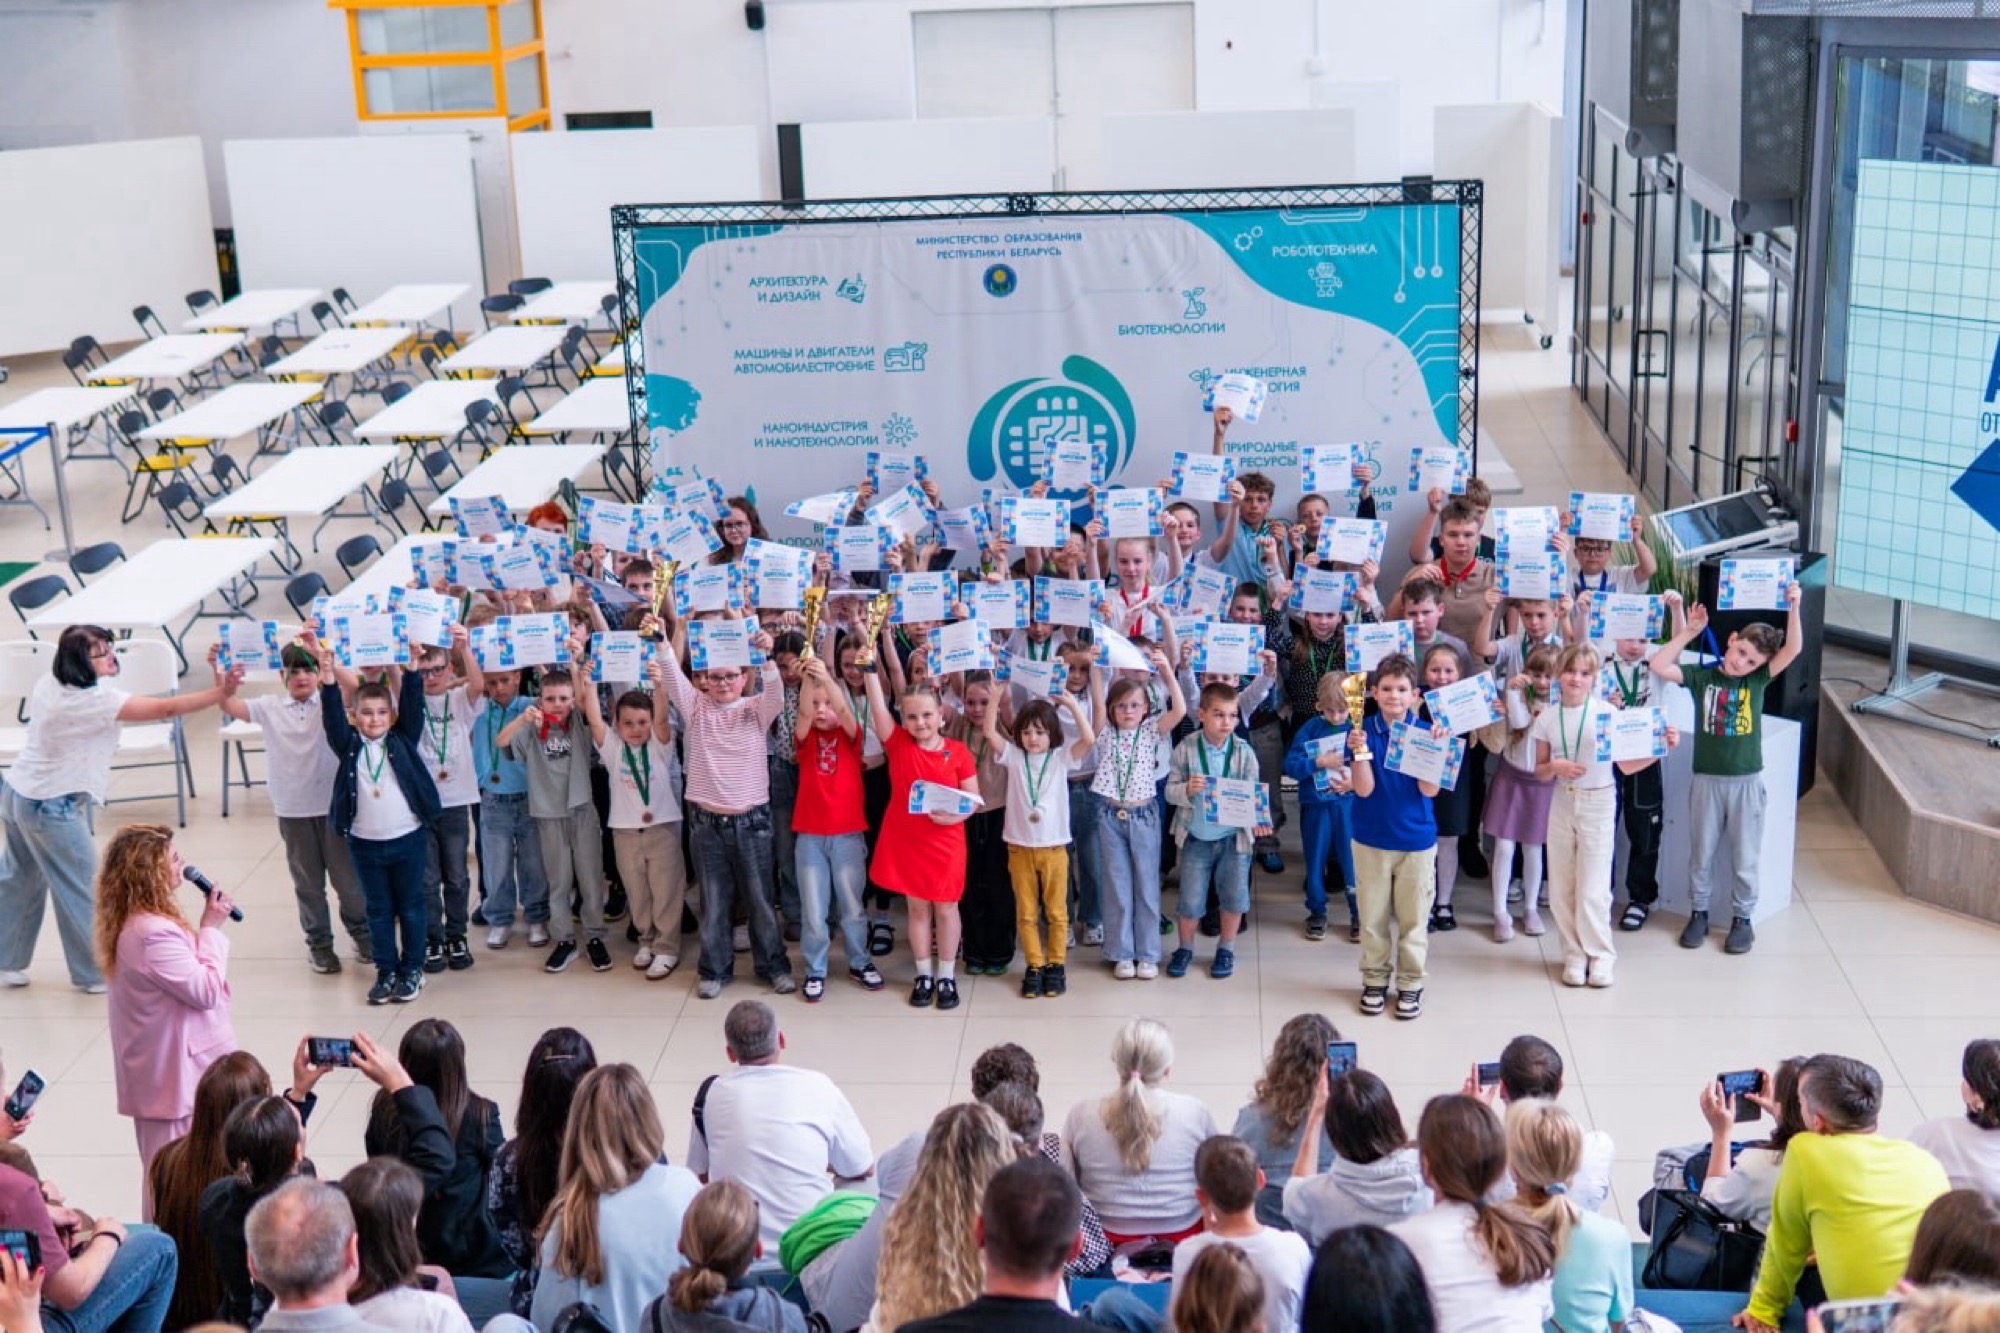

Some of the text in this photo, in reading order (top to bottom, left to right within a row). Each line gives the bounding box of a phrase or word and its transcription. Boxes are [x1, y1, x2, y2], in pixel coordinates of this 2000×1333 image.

[916, 232, 1082, 245] МИНИСТЕРСТВО ОБРАЗОВАНИЯ
[937, 247, 1062, 260] РЕСПУБЛИКИ БЕЛАРУСЬ
[1272, 243, 1378, 257] РОБОТОТЕХНИКА
[749, 275, 828, 287] АРХИТЕКТУРА
[757, 288, 821, 303] И ДИЗАЙН
[1118, 323, 1226, 336] БИОТЕХНОЛОГИИ
[734, 345, 875, 360] МАШИНЫ И ДВИГАТЕЛИ
[733, 360, 875, 374] АВТОМОБИЛЕСТРОЕНИЕ
[1268, 381, 1300, 393] ОГИЯ
[763, 421, 868, 434] НАНОИНДУСТРИЯ
[754, 435, 879, 448] И НАНОТЕХНОЛОГИИ
[1224, 440, 1298, 454] ПРИРОДНЫЕ
[1241, 455, 1298, 468] РЕСУРСЫ
[1349, 500, 1393, 512] ХИЯ
